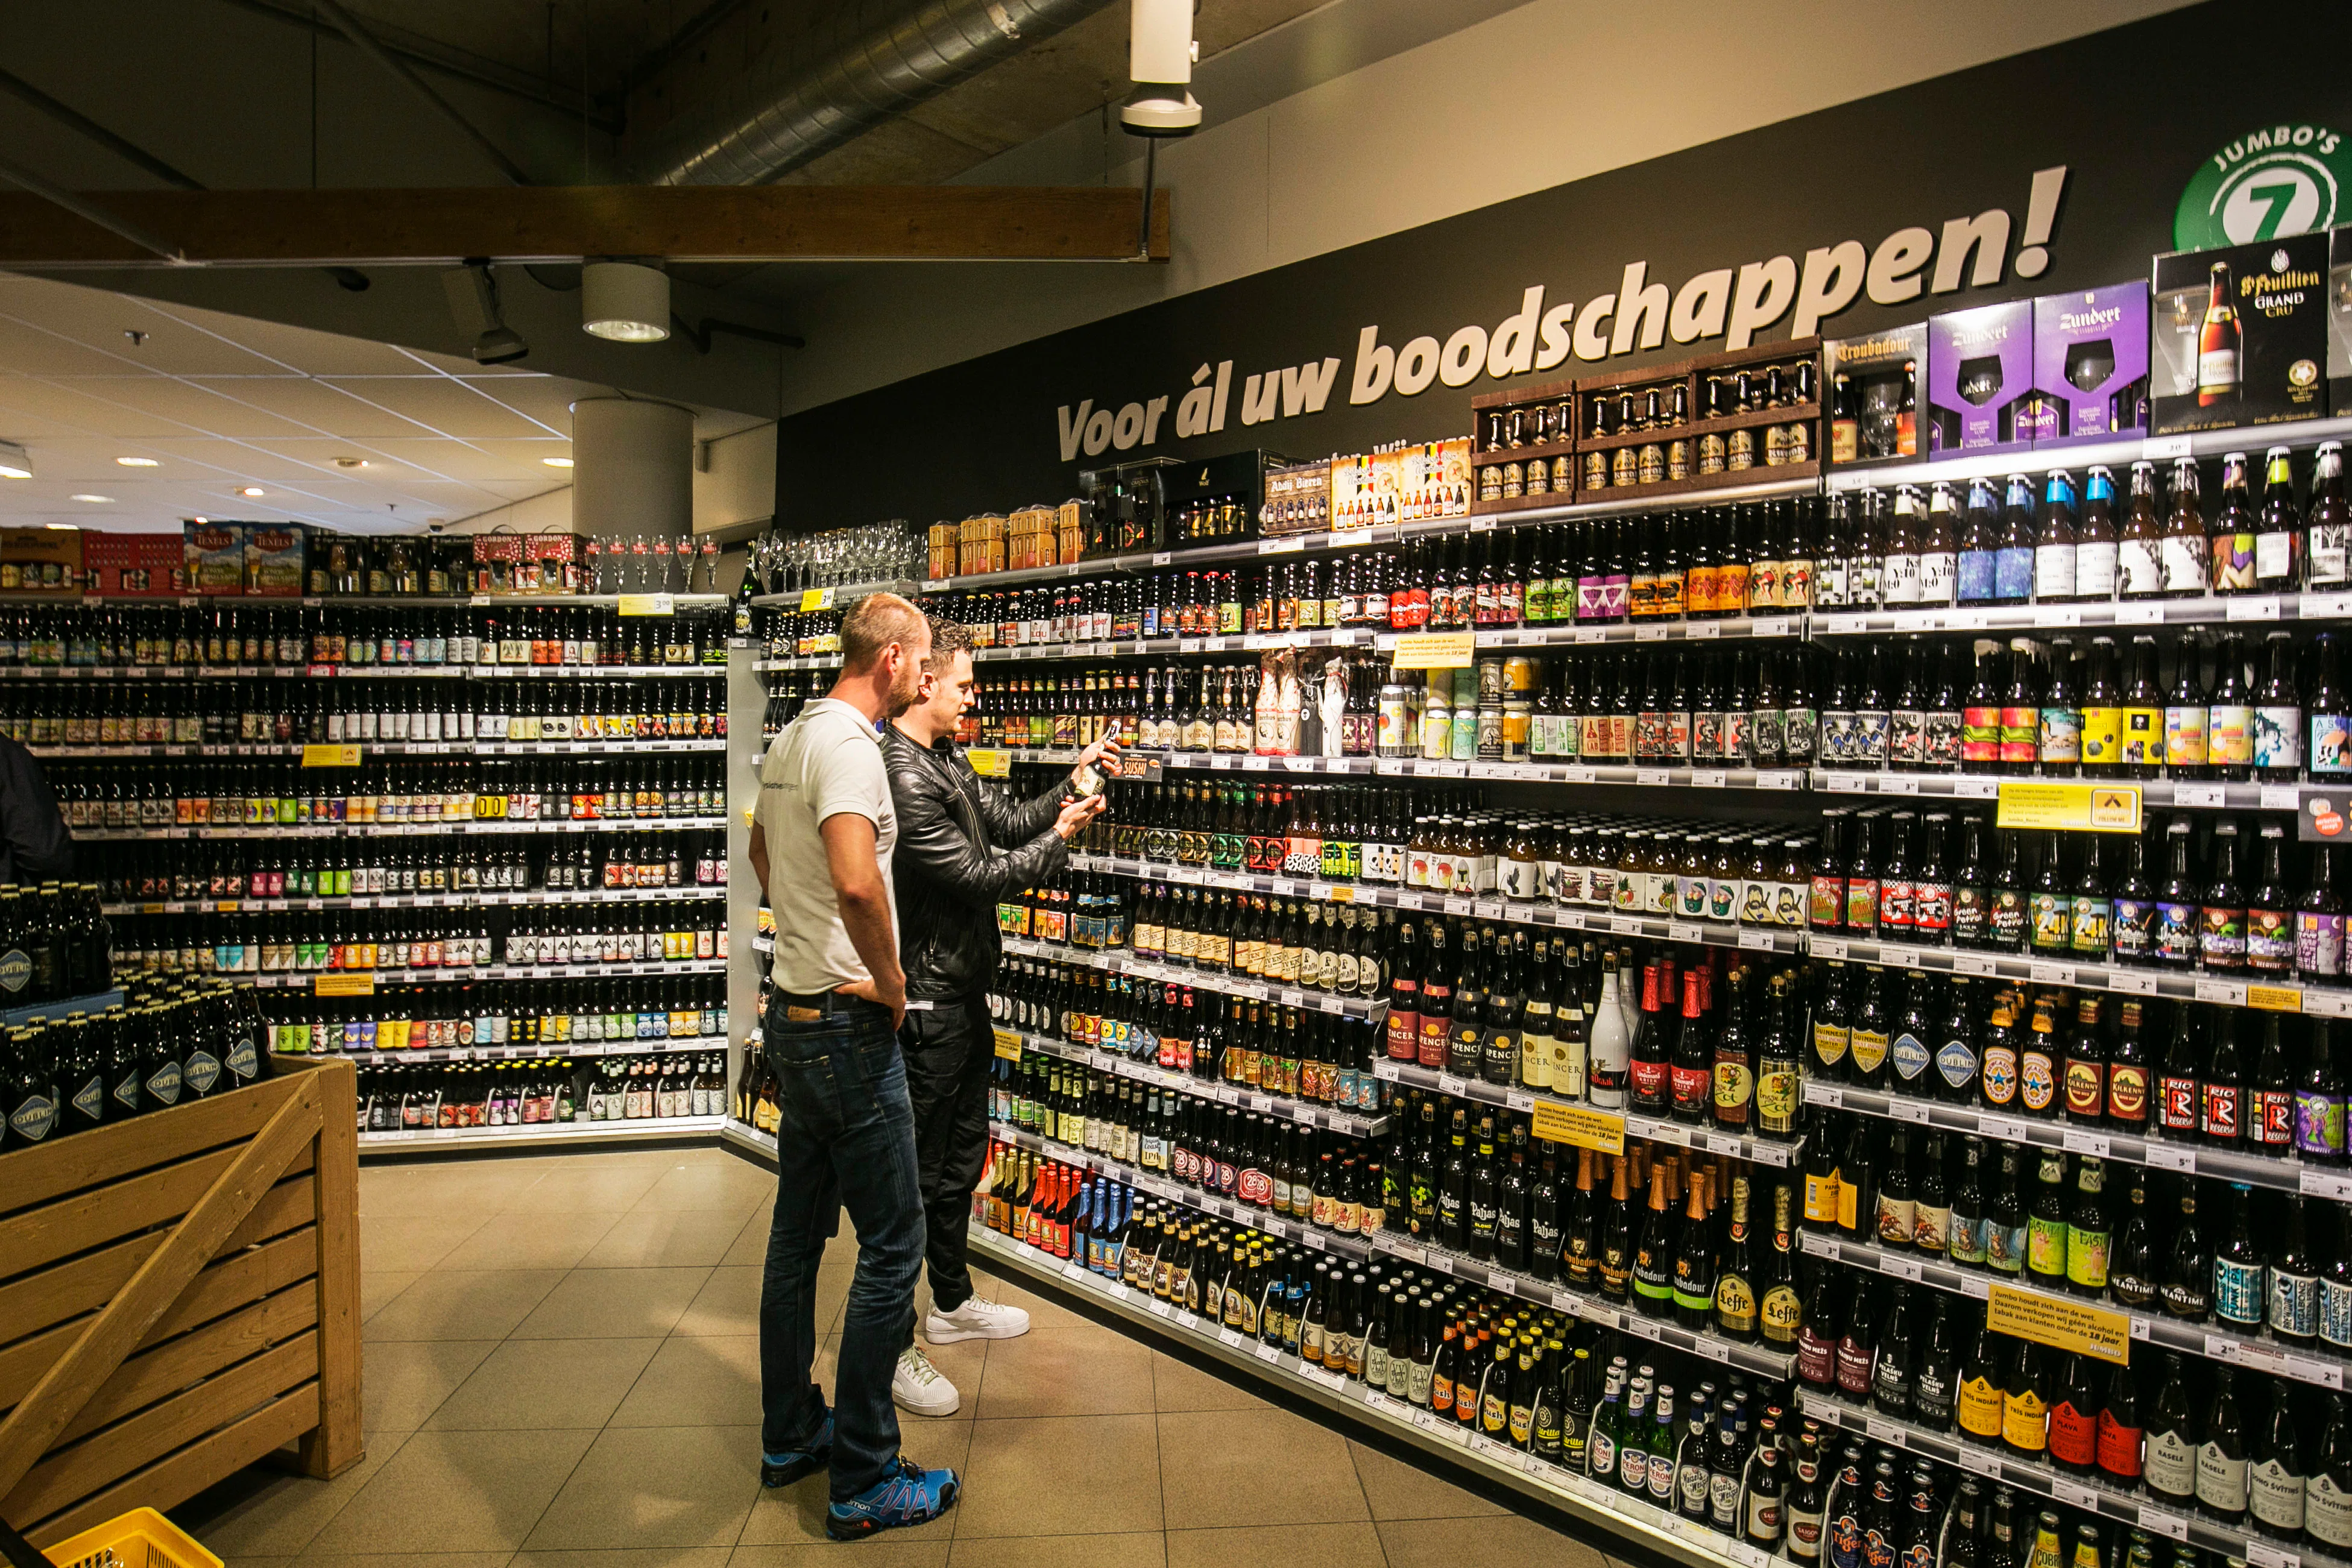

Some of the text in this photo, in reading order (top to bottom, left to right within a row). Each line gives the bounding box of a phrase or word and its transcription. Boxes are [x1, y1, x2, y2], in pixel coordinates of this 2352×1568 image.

[2213, 126, 2341, 172] JUMBO'S
[2250, 183, 2297, 242] 7
[2255, 292, 2304, 309] GRAND
[1058, 166, 2068, 462] Voor ál uw boodschappen!
[2060, 306, 2121, 330] Zundert
[2266, 306, 2292, 318] CRU
[1952, 326, 2008, 347] Zundert
[1837, 336, 1911, 361] Troubadour
[2018, 412, 2055, 427] Zundert
[1271, 477, 1322, 492] Abdij Bieren
[197, 534, 230, 546] TEXELS
[258, 535, 293, 548] TEXELS
[1123, 763, 1147, 775] SUSHI
[1954, 907, 1977, 916] Green
[1993, 911, 2019, 920] Green
[1956, 914, 1982, 924] Patrol
[1996, 918, 2023, 928] Patrol
[2075, 912, 2108, 937] 24K
[2075, 936, 2099, 945] GOLDEN
[1320, 965, 1338, 977] Goliath
[1816, 1027, 1847, 1037] GUINNESS
[1854, 1033, 1886, 1044] GUINNESS
[232, 1053, 256, 1065] DUBL
[1895, 1050, 1925, 1060] DUBLIN
[1940, 1057, 1974, 1067] DUBLIN
[1987, 1061, 2012, 1075] NEWCASTLE
[186, 1063, 218, 1077] DUBLIN
[2023, 1065, 2048, 1081] NEWCASTLE
[154, 1077, 180, 1090] DUBL
[2067, 1078, 2098, 1091] KILKENNY
[2113, 1083, 2145, 1095] KILKENNY
[2169, 1079, 2192, 1090] RIO
[2211, 1086, 2234, 1097] RIO
[2267, 1095, 2290, 1104] RIO
[16, 1108, 53, 1124] DUBLIN
[1556, 1116, 1577, 1126] verkopen
[1144, 1151, 1159, 1162] IPA
[1175, 1152, 1186, 1163] 28
[1189, 1157, 1199, 1168] 28
[1222, 1168, 1231, 1180] 28
[1247, 1174, 1257, 1187] 28
[1256, 1179, 1266, 1191] 28
[1471, 1202, 1496, 1221] Paljas
[1499, 1207, 1520, 1229] Paljas
[1533, 1218, 1558, 1238] Paljas
[2111, 1277, 2154, 1295] MEANTIME
[1995, 1291, 2017, 1302] Jumbo
[2019, 1297, 2039, 1308] houdt
[2160, 1288, 2204, 1306] MEANTIME
[2230, 1268, 2240, 1318] PUNK IPA
[1720, 1288, 1748, 1312] Leffe
[2297, 1280, 2306, 1332] VAGABOND
[1768, 1302, 1798, 1324] Leffe
[1995, 1299, 2021, 1311] Daarom
[2023, 1307, 2055, 1320] verkopen
[2069, 1318, 2086, 1327] géén
[2088, 1323, 2114, 1335] alcohol
[2332, 1287, 2341, 1340] VAGABOND
[1994, 1308, 2013, 1318] tabak
[2029, 1317, 2055, 1329] klanten
[2057, 1324, 2076, 1334] onder
[2089, 1331, 2099, 1341] 18
[2101, 1333, 2121, 1346] jaar.
[2090, 1343, 2122, 1358] JUMBO
[2158, 1450, 2184, 1463] RASELE
[1623, 1459, 1646, 1471] PERONI
[2201, 1460, 2226, 1475] RASELE
[1650, 1467, 1673, 1479] PERONI
[1845, 1473, 1857, 1484] Tiger
[1874, 1488, 1886, 1498] Tiger
[1797, 1528, 1819, 1537] SAIGON
[1833, 1531, 1862, 1552] Tiger
[1863, 1543, 1891, 1566] Tiger
